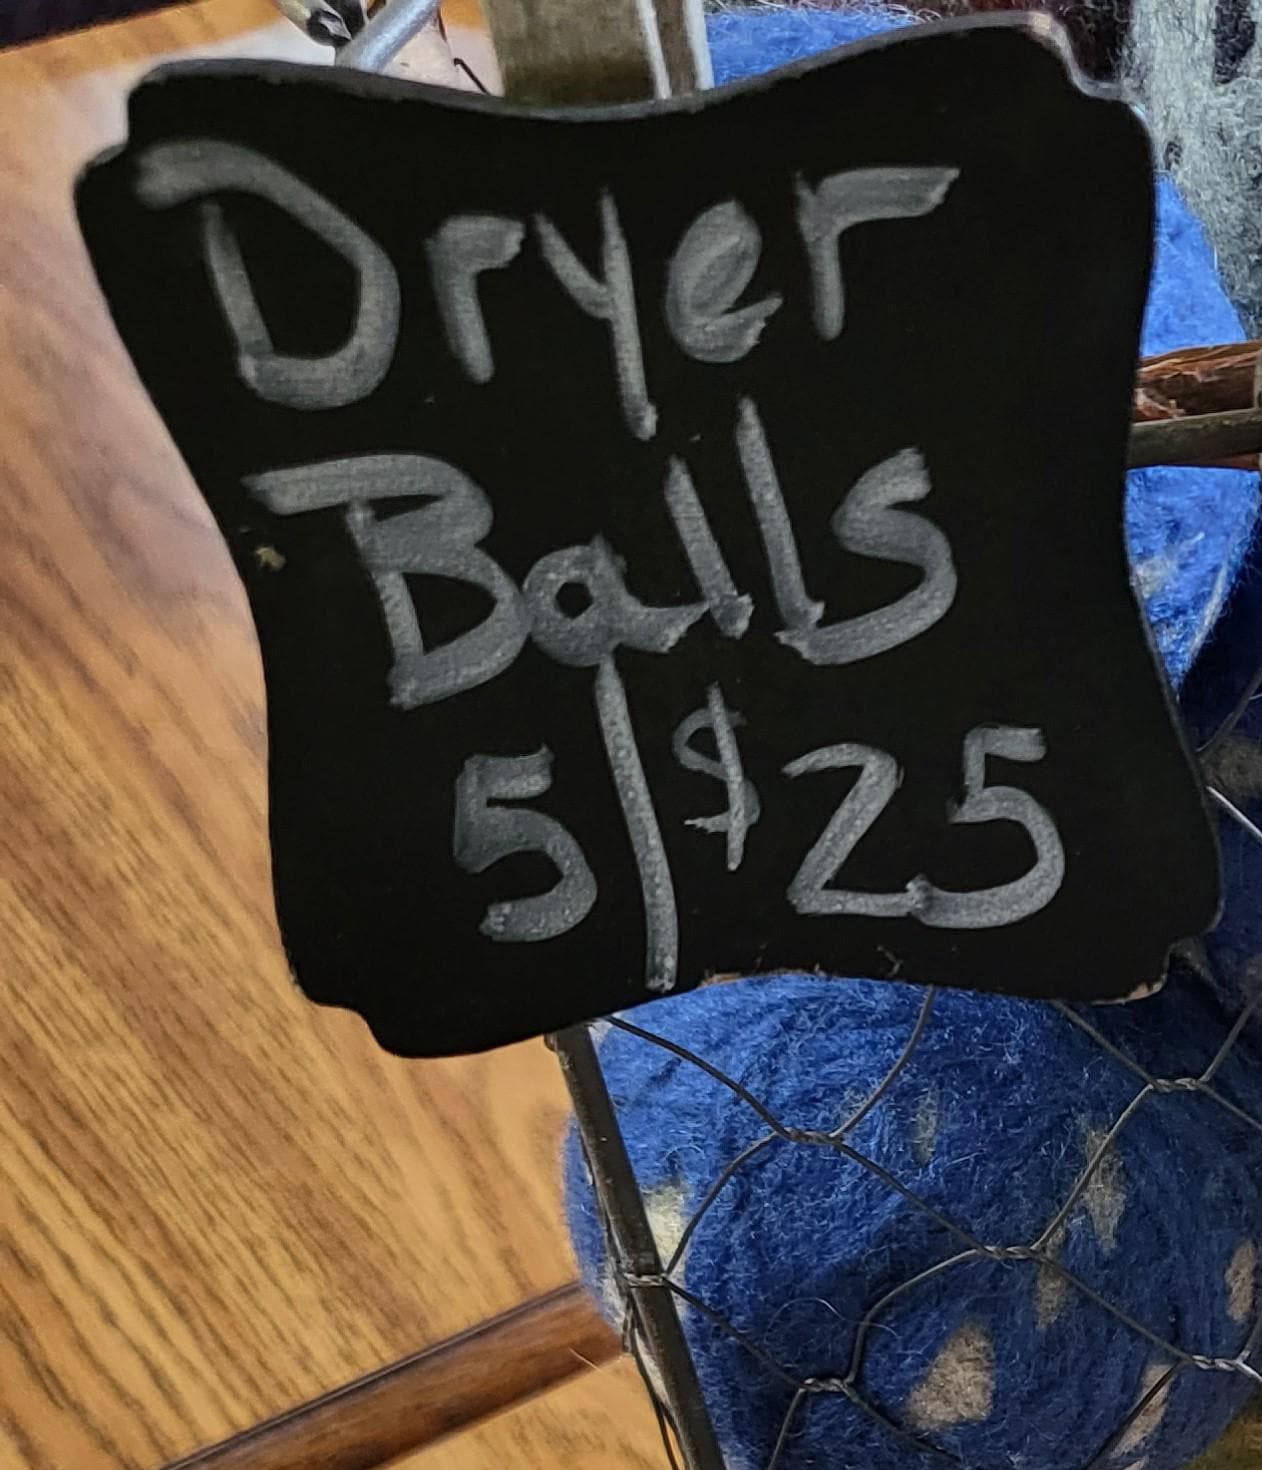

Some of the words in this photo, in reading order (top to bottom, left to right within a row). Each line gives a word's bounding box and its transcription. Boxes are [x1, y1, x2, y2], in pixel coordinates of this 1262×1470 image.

[136, 141, 960, 440] Dryer
[246, 397, 958, 706] Balls
[453, 658, 1065, 992] 5/$25
